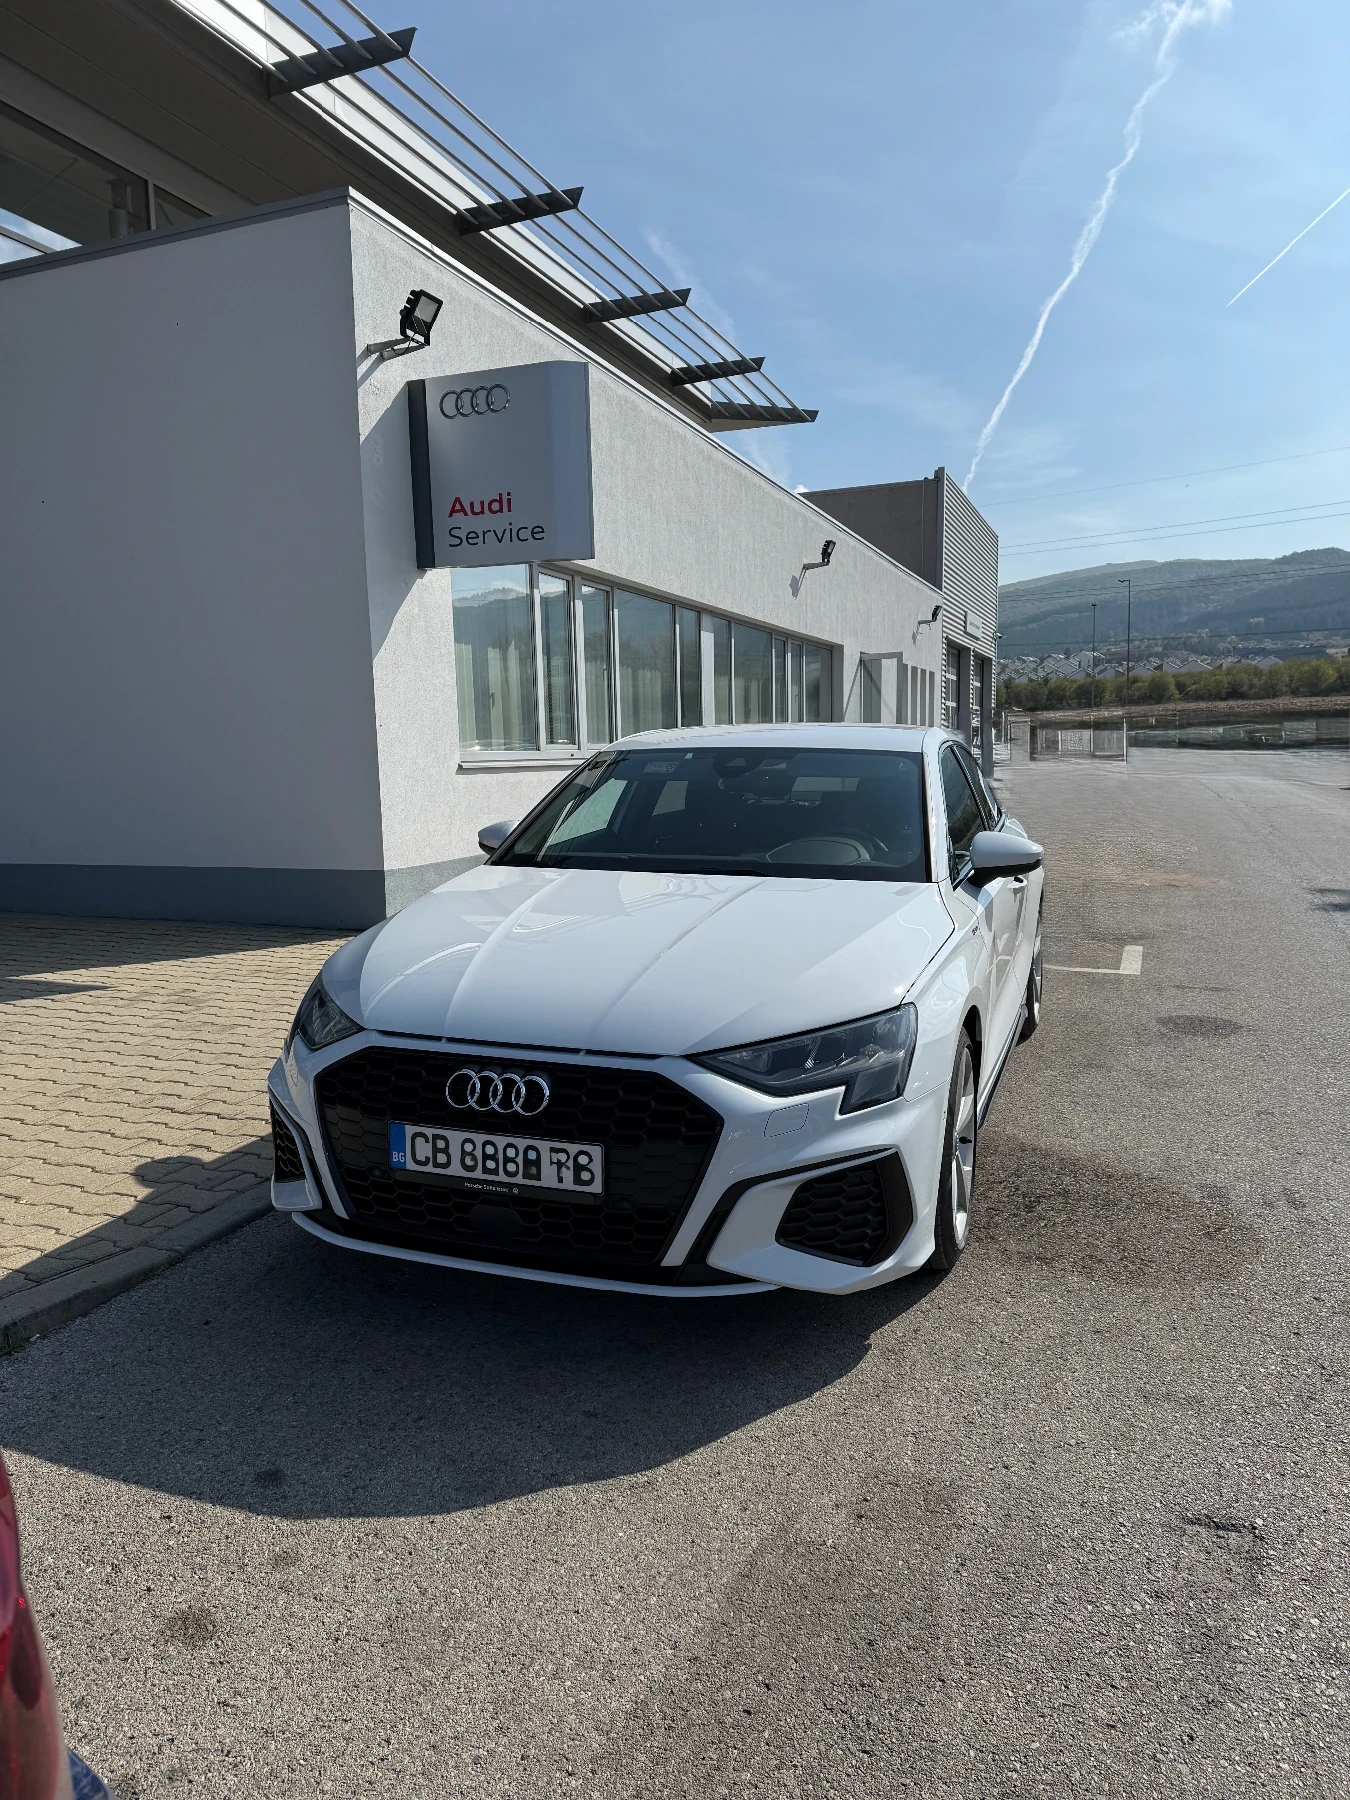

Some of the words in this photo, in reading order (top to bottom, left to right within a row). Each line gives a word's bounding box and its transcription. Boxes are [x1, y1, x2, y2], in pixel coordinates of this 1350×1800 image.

[448, 492, 512, 518] Audi
[448, 522, 545, 548] Service
[392, 1151, 405, 1163] BG
[410, 1131, 452, 1169] CB
